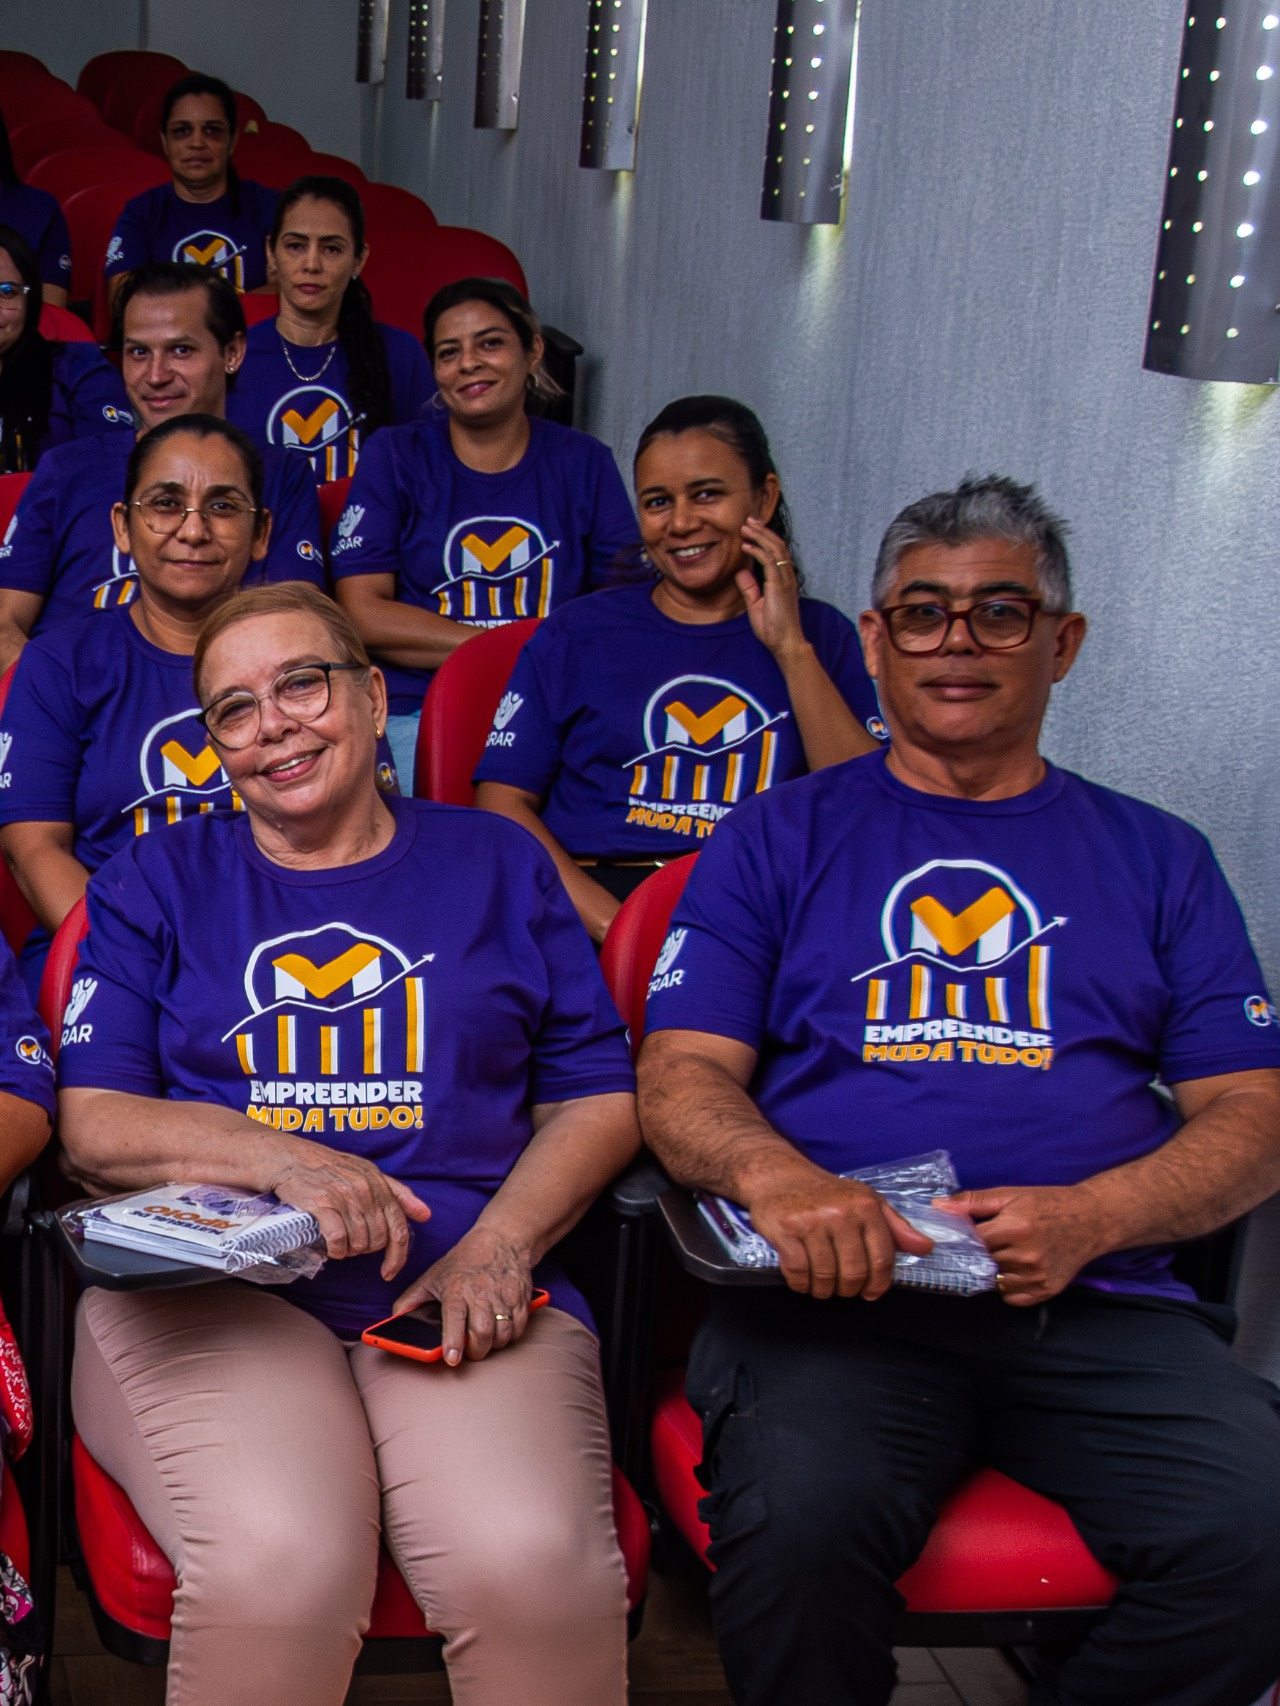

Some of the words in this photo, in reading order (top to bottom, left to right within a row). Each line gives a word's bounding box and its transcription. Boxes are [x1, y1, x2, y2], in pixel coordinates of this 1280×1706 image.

[625, 807, 693, 835] MUDA
[864, 1018, 1054, 1047] EMPREENDER
[863, 1041, 955, 1063] MUDA
[957, 1040, 1054, 1071] TUDO!
[250, 1080, 423, 1105] EMPREENDER
[246, 1104, 325, 1132] MUDA
[329, 1105, 424, 1132] TUDO!
